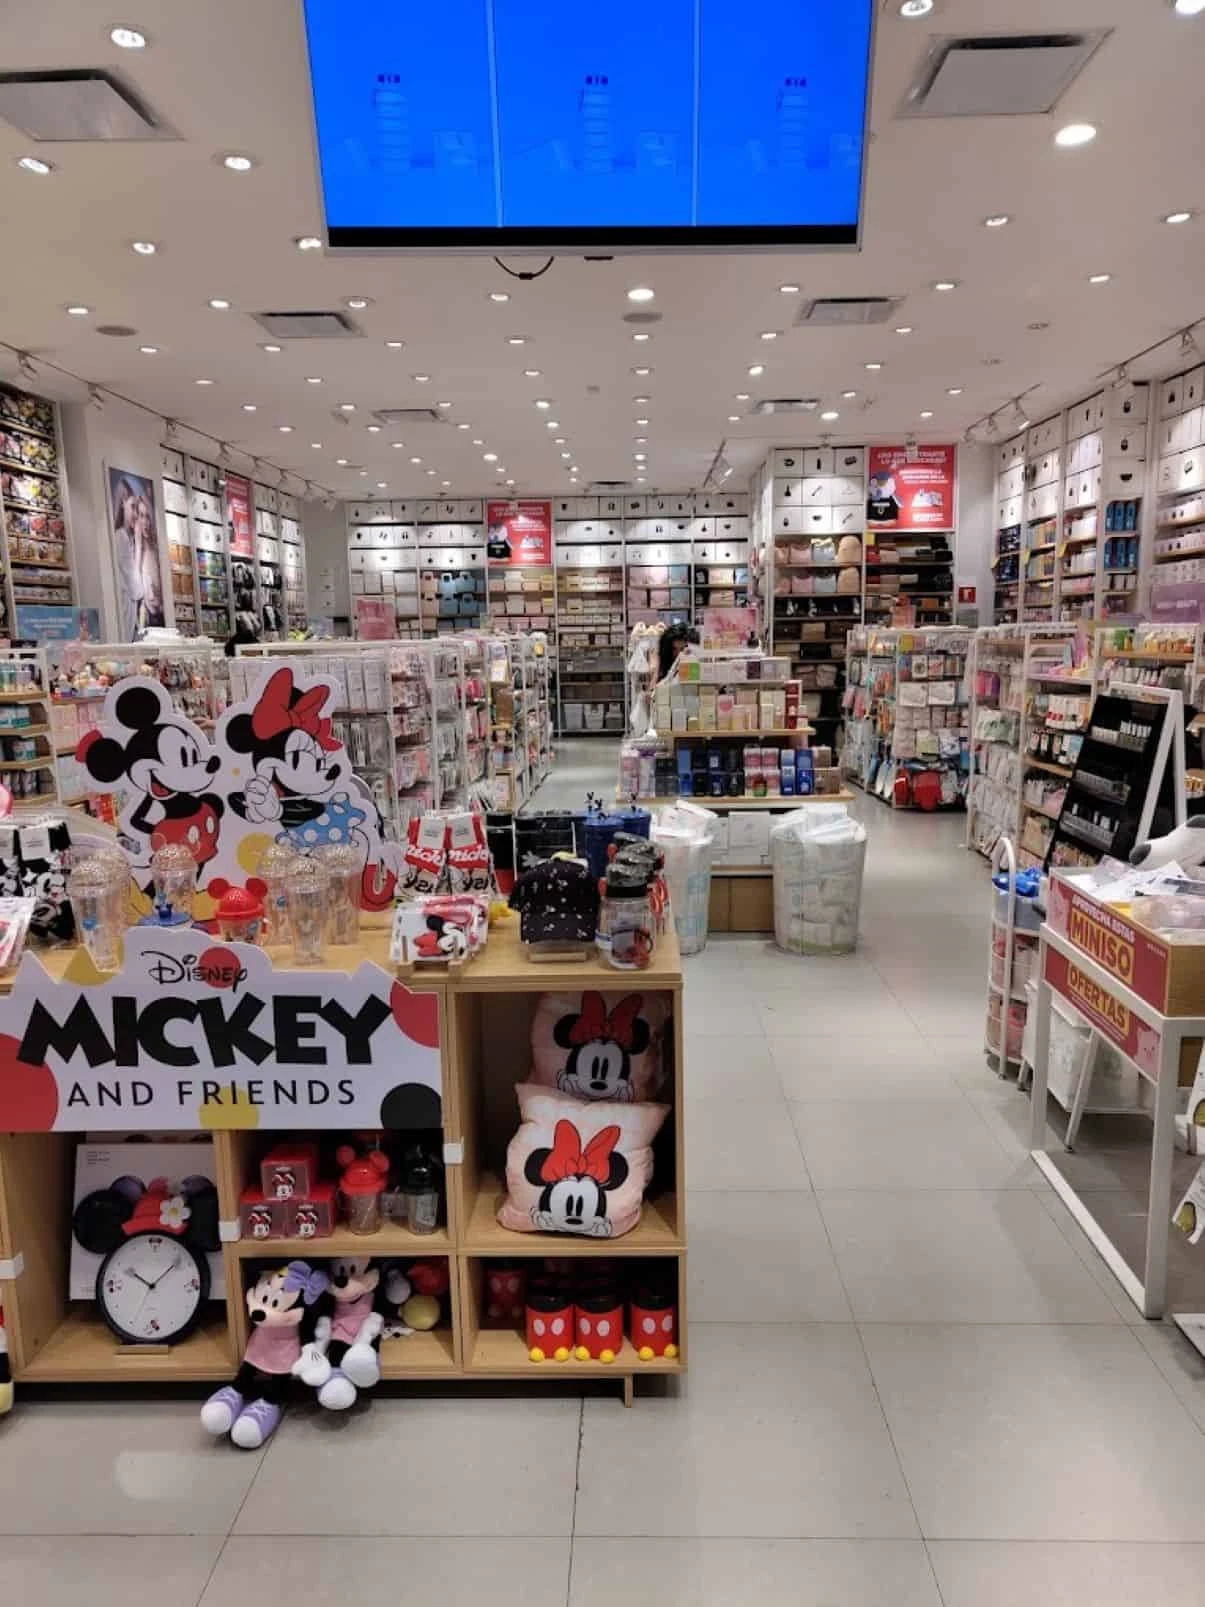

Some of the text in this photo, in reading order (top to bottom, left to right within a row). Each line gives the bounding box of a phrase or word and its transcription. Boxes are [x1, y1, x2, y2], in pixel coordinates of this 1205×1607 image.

[1071, 911, 1131, 977] MINISO
[1071, 967, 1125, 1028] OFERTAS
[17, 992, 393, 1068] MICKEY
[67, 1079, 355, 1107] AND FRIENDS
